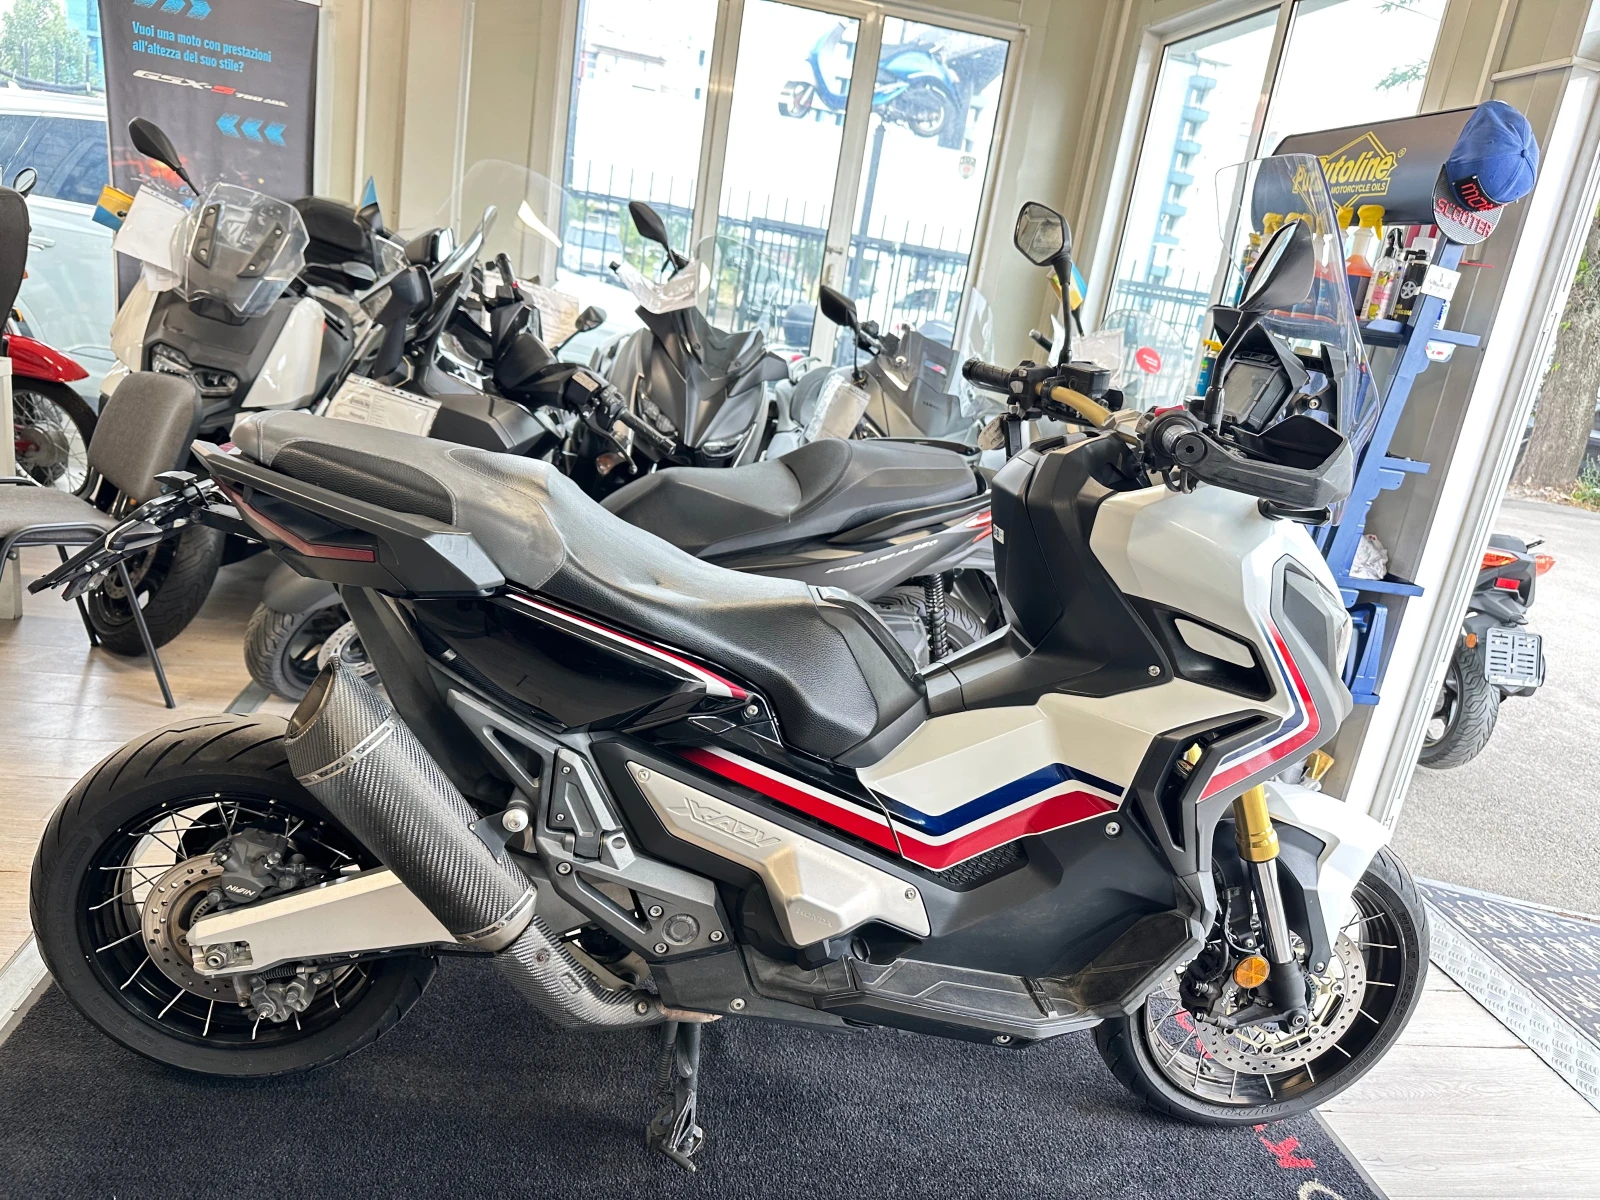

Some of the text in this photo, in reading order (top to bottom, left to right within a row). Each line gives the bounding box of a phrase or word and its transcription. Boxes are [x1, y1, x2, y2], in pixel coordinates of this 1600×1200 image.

[132, 21, 272, 63] Vuoi una moto con prestazioni
[183, 50, 198, 64] del
[199, 55, 217, 68] suo
[218, 58, 245, 73] stile?
[1330, 182, 1387, 194] MOTORCYCLE OILS
[1435, 197, 1493, 238] SCOOTER
[795, 907, 833, 928] HONDA
